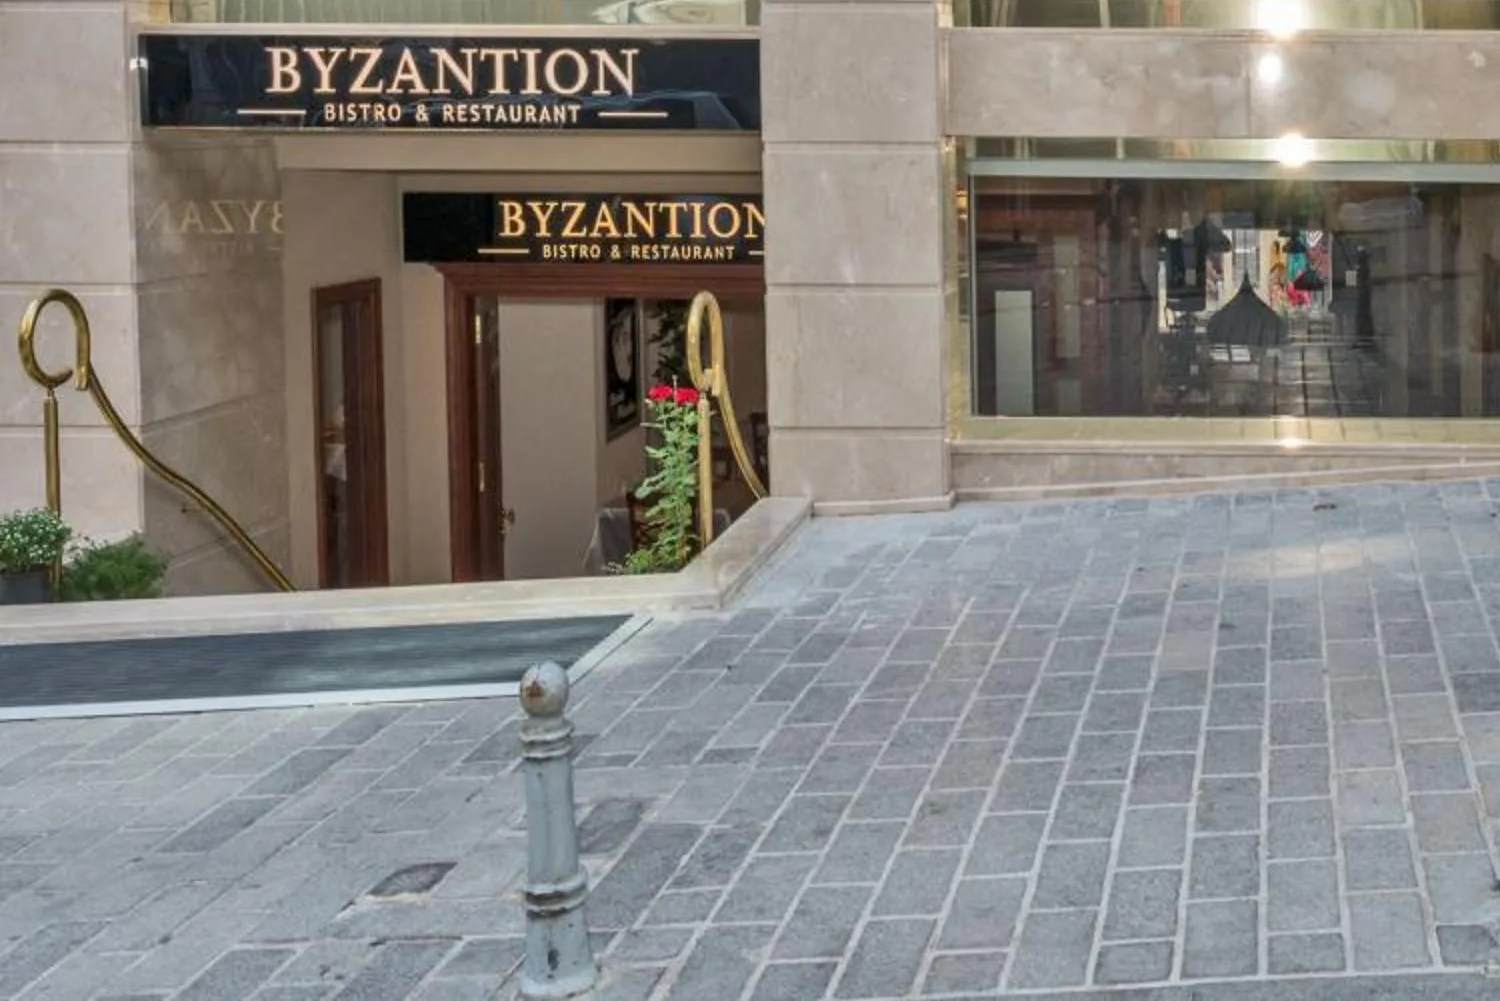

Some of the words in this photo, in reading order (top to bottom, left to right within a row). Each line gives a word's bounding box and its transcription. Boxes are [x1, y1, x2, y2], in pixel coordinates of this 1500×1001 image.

[265, 47, 638, 95] BYZANTION
[324, 103, 401, 122] BISTRO
[415, 104, 430, 122] &
[442, 104, 581, 123] RESTAURANT
[542, 244, 600, 259] BISTRO
[611, 245, 621, 259] &
[631, 245, 735, 260] RESTAURANT
